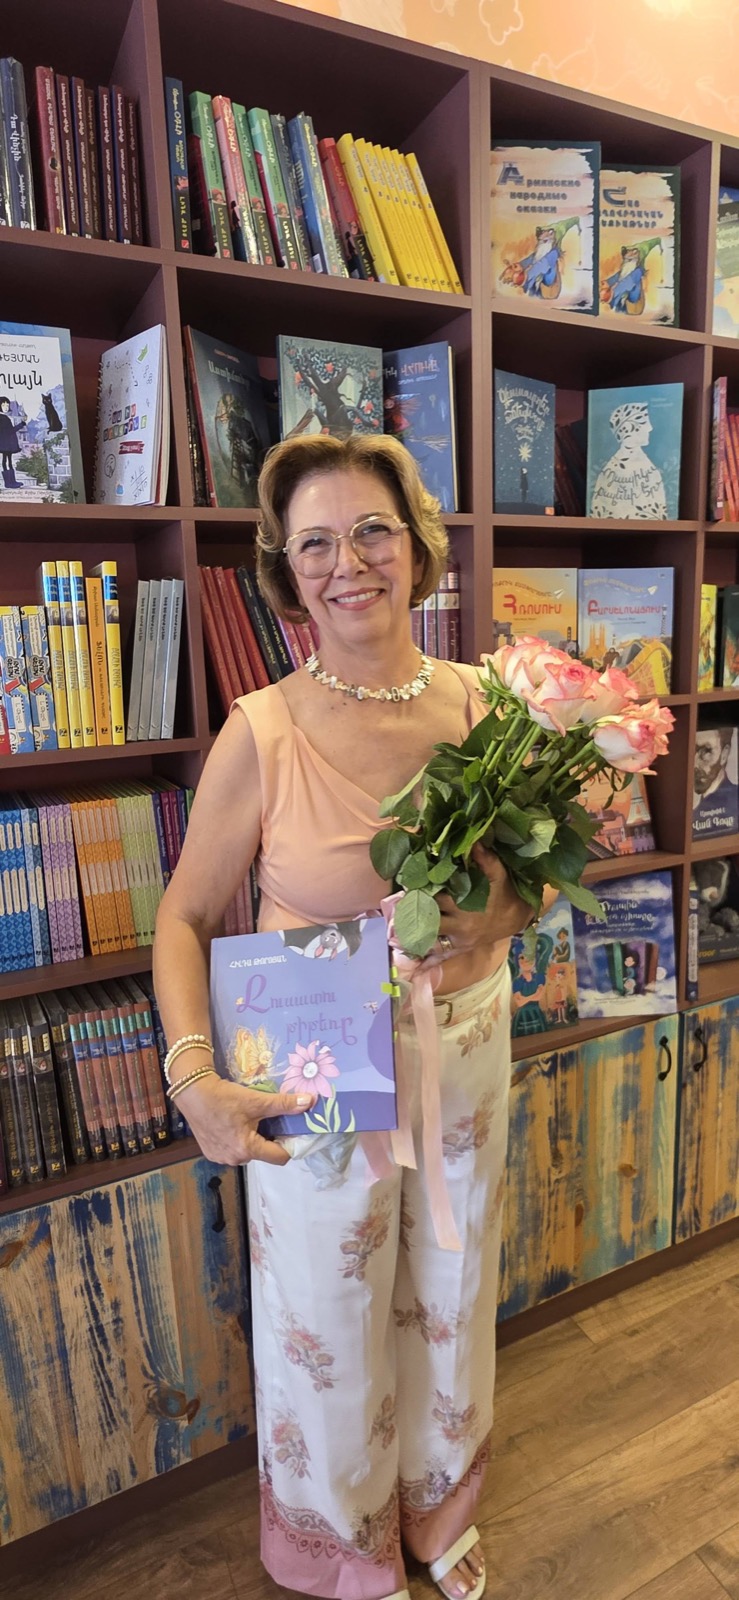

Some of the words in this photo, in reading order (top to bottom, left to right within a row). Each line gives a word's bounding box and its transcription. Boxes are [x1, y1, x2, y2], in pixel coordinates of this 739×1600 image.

[510, 192, 567, 200] народные
[516, 205, 557, 214] сказки
[602, 210, 663, 219] ՂՈՎՐԴԱԿԱՆ
[601, 219, 656, 228] ԵՔԻԱԹՆԵՐ
[503, 594, 562, 615] ՀՌՈՄՈՒՄ
[587, 600, 661, 616] ԲԱՐՍԵԼՈՆԱՅՈՒՄ
[692, 819, 711, 830] Վան
